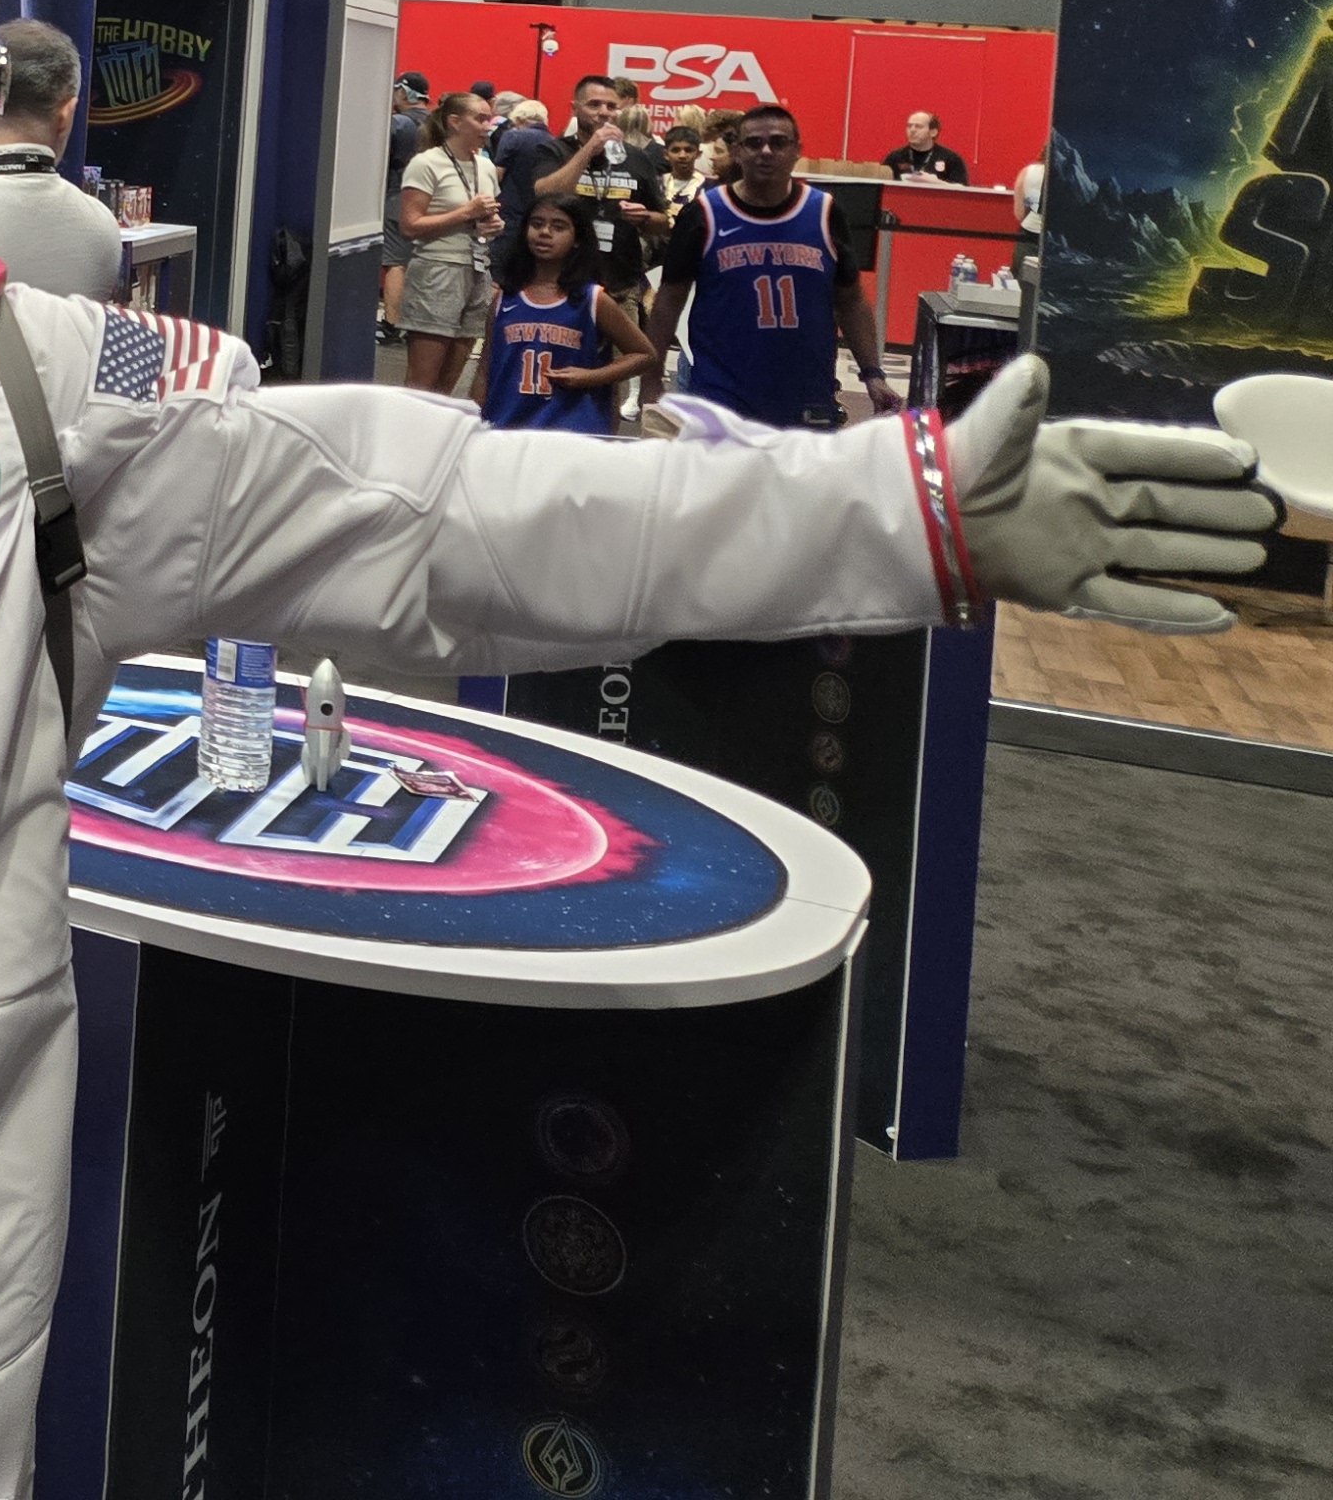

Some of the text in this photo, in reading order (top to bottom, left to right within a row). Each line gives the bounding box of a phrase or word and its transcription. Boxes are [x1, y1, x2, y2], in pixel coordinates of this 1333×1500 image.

[97, 17, 213, 62] THE HOBBY
[607, 42, 780, 105] PSA
[716, 243, 825, 273] NEW YORK
[753, 275, 800, 329] 11
[503, 322, 583, 350] NEW YORK
[519, 349, 553, 395] 11
